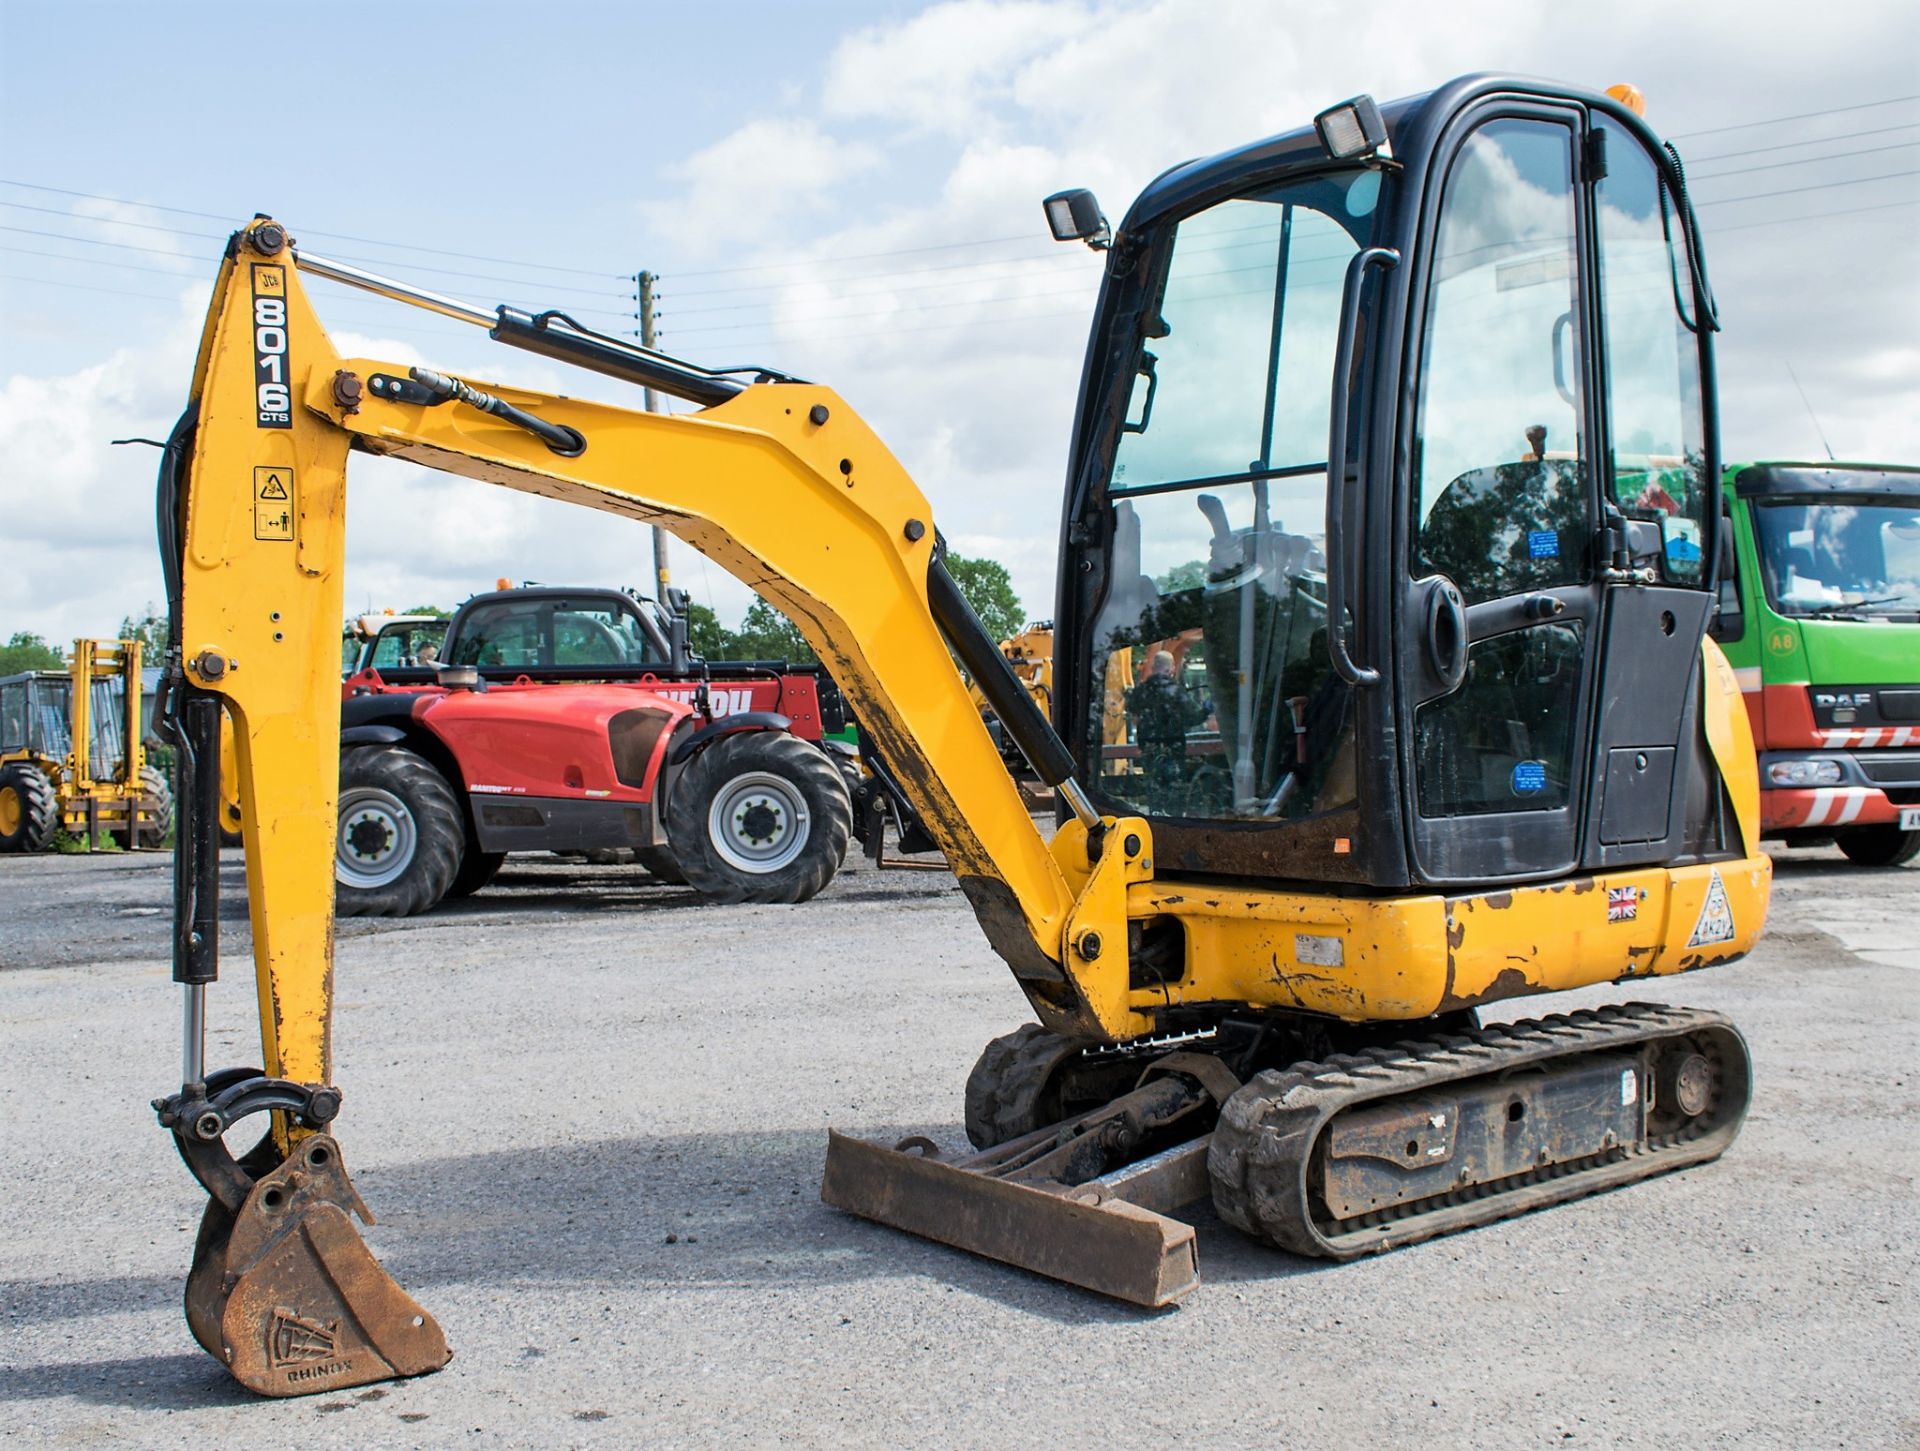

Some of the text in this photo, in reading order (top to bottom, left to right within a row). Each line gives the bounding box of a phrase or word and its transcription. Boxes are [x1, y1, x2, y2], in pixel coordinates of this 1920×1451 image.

[255, 298, 289, 412] 8016
[259, 412, 289, 422] CTS
[1771, 634, 1793, 650] A8
[1815, 693, 1871, 708] DAF
